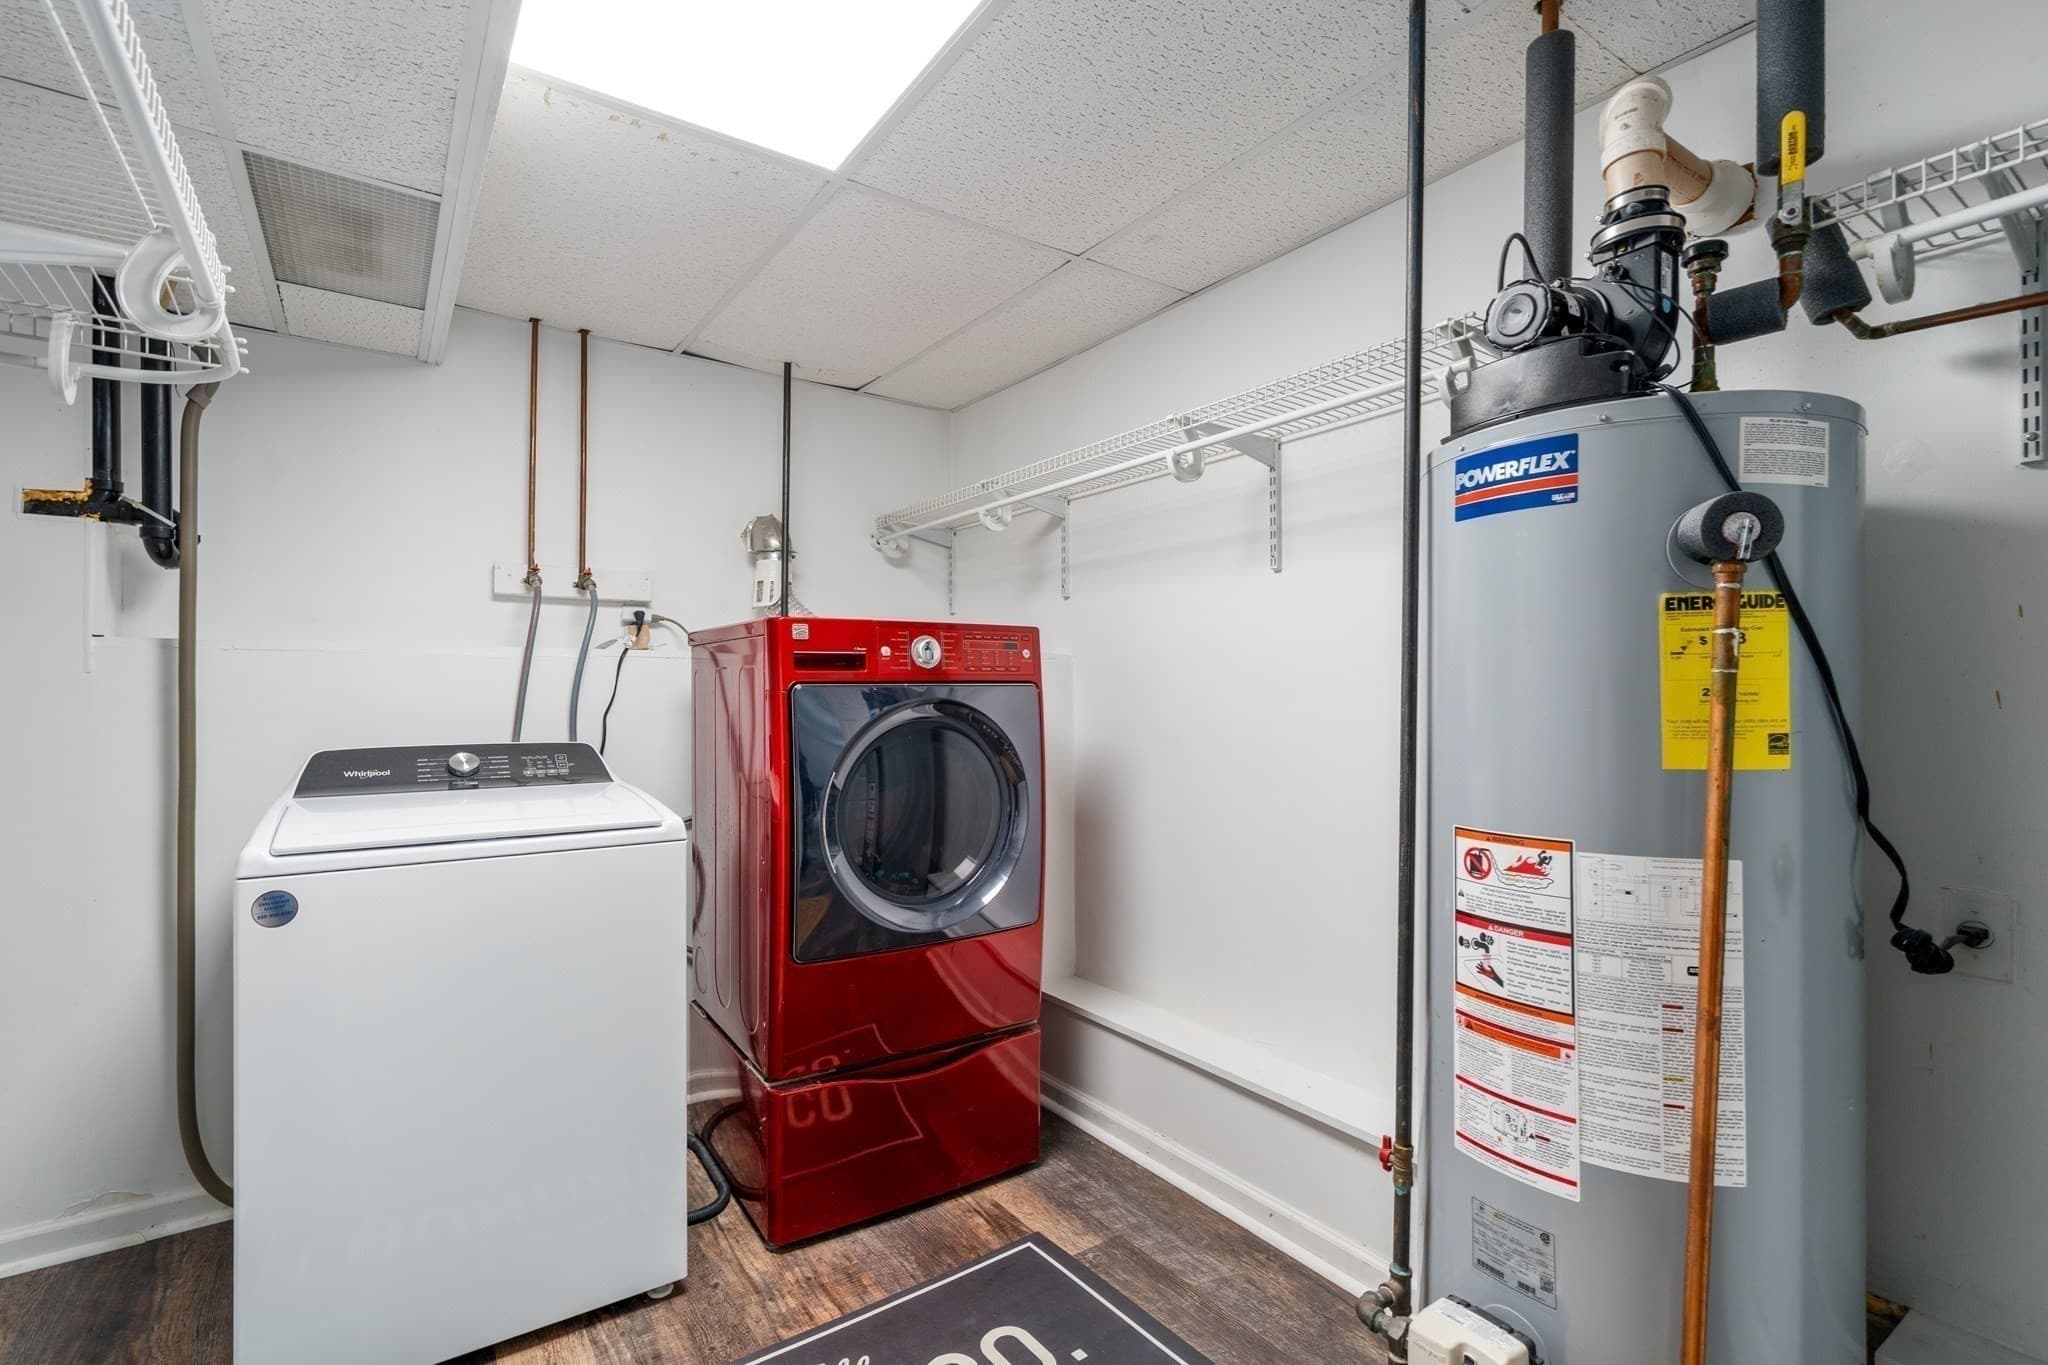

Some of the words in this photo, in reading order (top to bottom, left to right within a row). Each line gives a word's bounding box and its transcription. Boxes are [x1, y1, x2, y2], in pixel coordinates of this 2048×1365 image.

[1455, 449, 1571, 491] POWERFLEX
[343, 769, 391, 778] Whirlpool
[1493, 924, 1525, 938] DANGER
